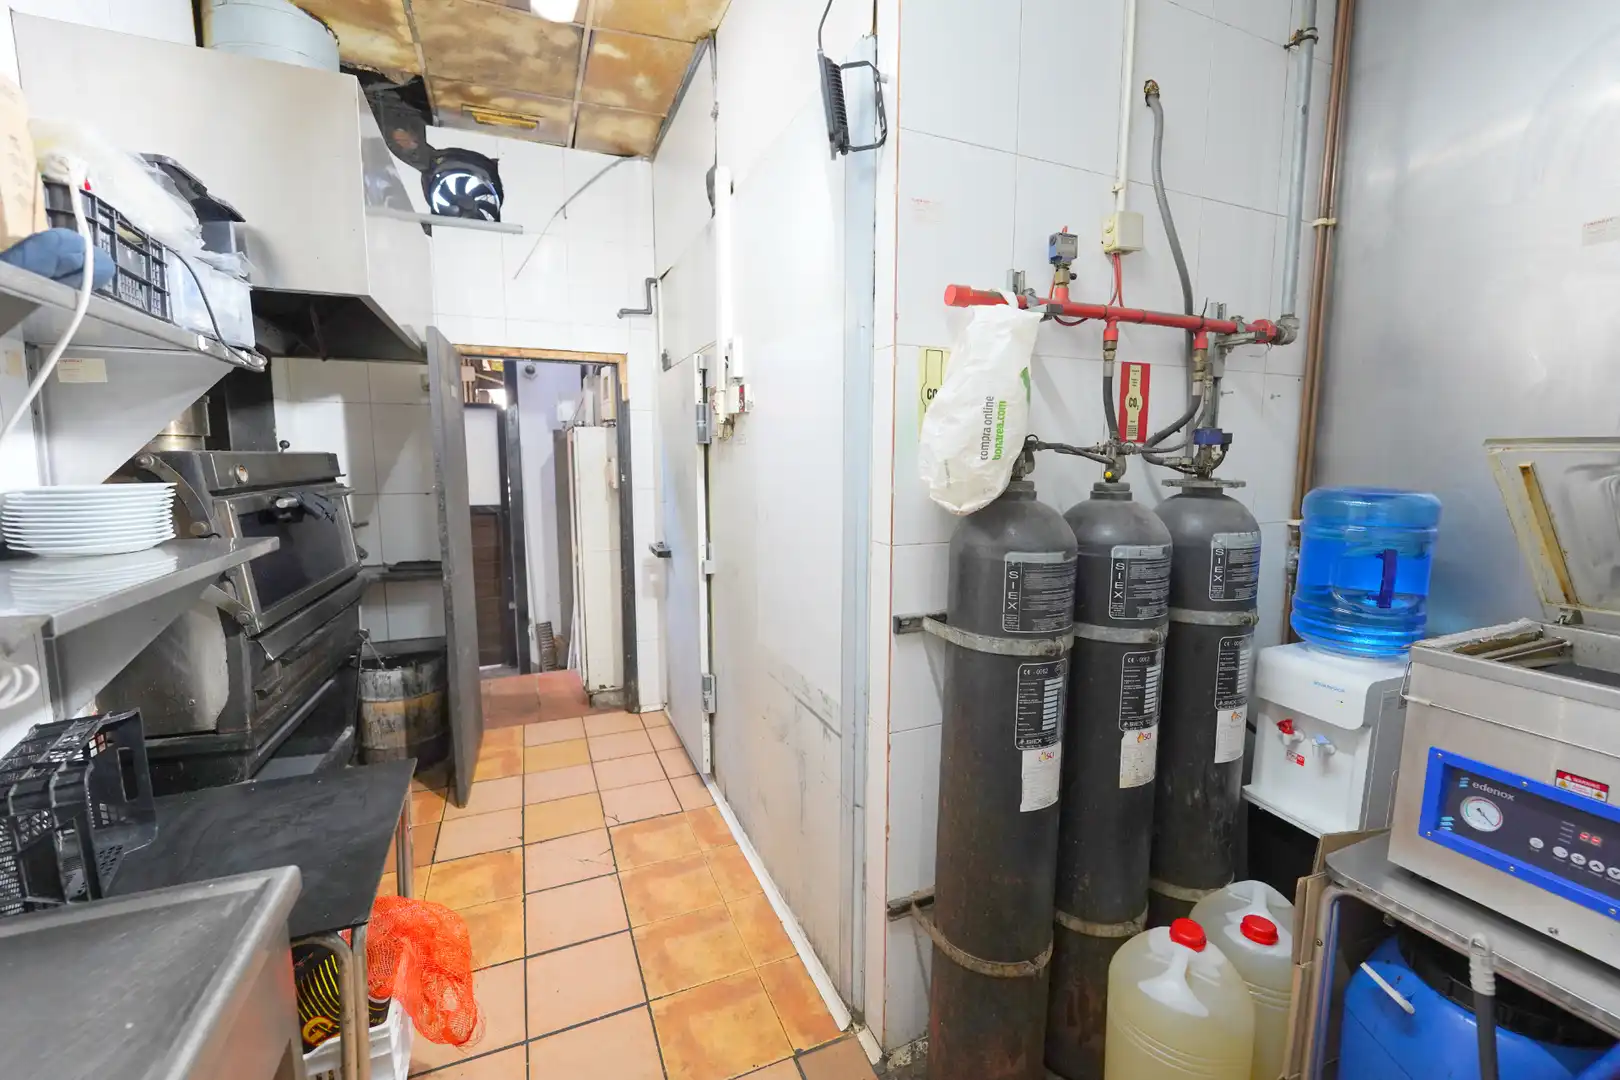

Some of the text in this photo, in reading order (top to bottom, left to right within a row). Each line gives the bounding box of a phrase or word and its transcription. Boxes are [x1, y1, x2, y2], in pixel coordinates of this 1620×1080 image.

[980, 396, 995, 461] compra online
[992, 400, 1008, 461] bonarea.com
[1113, 562, 1125, 599] SIEX
[1213, 548, 1225, 582] SIEX
[1007, 570, 1019, 610] SIEX
[1472, 781, 1515, 801] edenox
